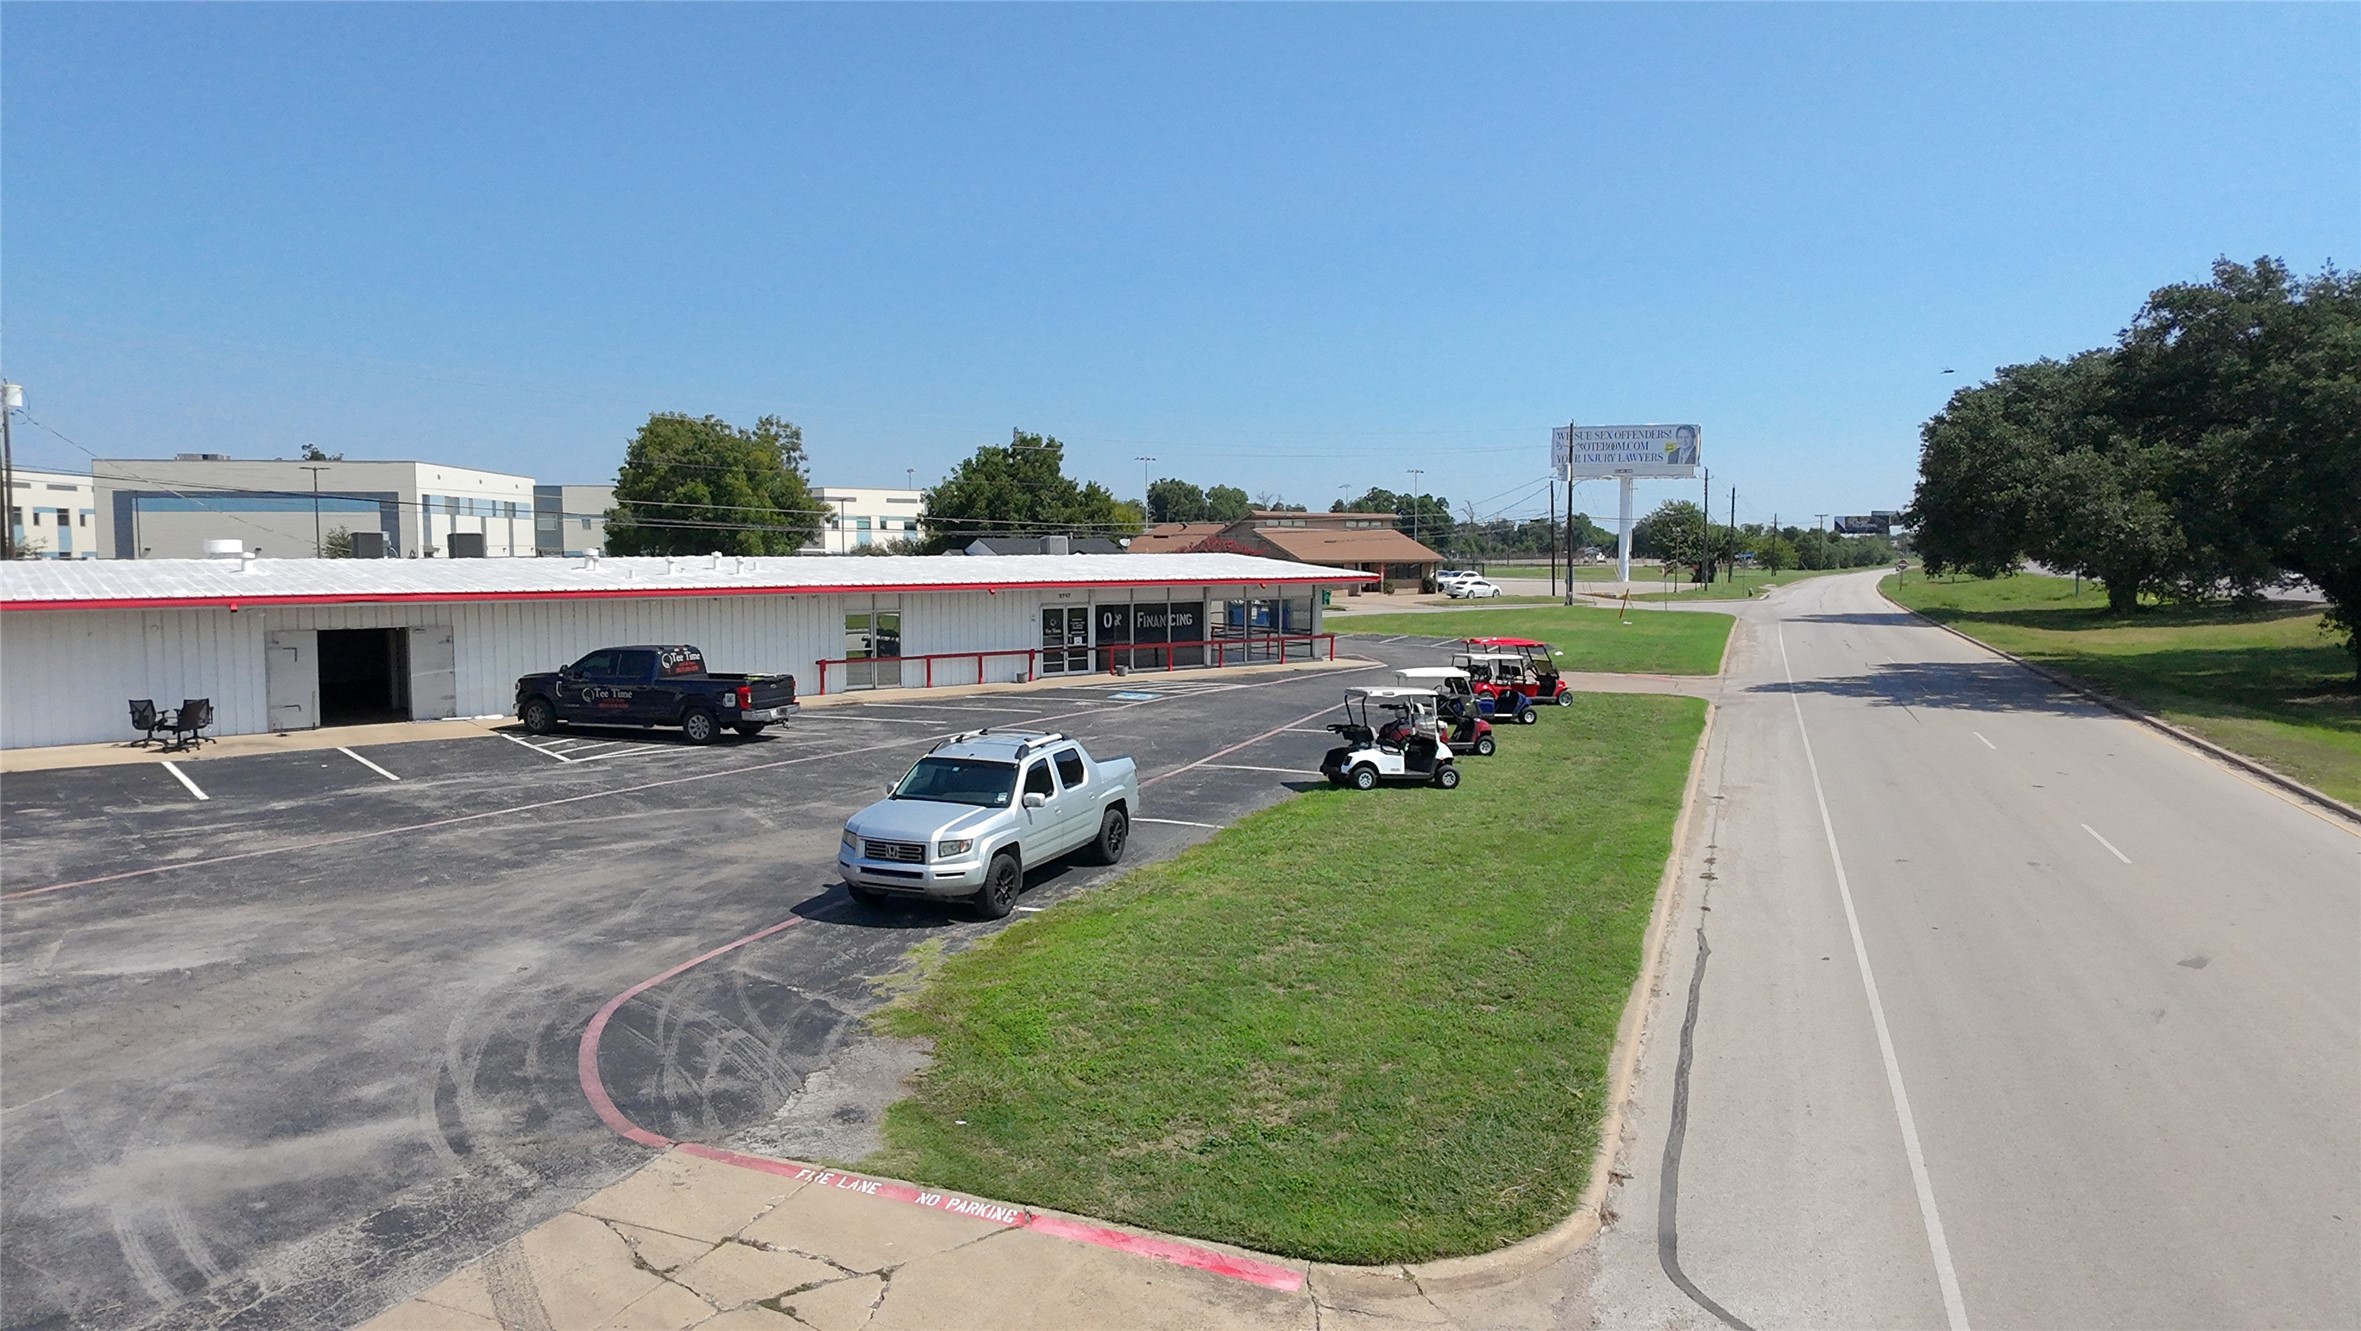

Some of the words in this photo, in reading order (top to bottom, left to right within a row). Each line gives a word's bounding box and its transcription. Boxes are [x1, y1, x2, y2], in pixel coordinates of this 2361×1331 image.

[1574, 431, 1591, 440] SUE
[1595, 431, 1613, 440] SEX
[1614, 430, 1673, 440] OFFENDERS!
[1556, 454, 1581, 464] YOR
[1583, 453, 1618, 463] INJURY
[1618, 452, 1664, 462] LAWYERS
[670, 652, 684, 662] Tee
[685, 651, 700, 661] Time
[594, 688, 609, 698] Tee
[611, 688, 633, 698] Time
[837, 1176, 883, 1194] LANE
[915, 1192, 941, 1206] NO
[945, 1198, 1018, 1223] PARKING
